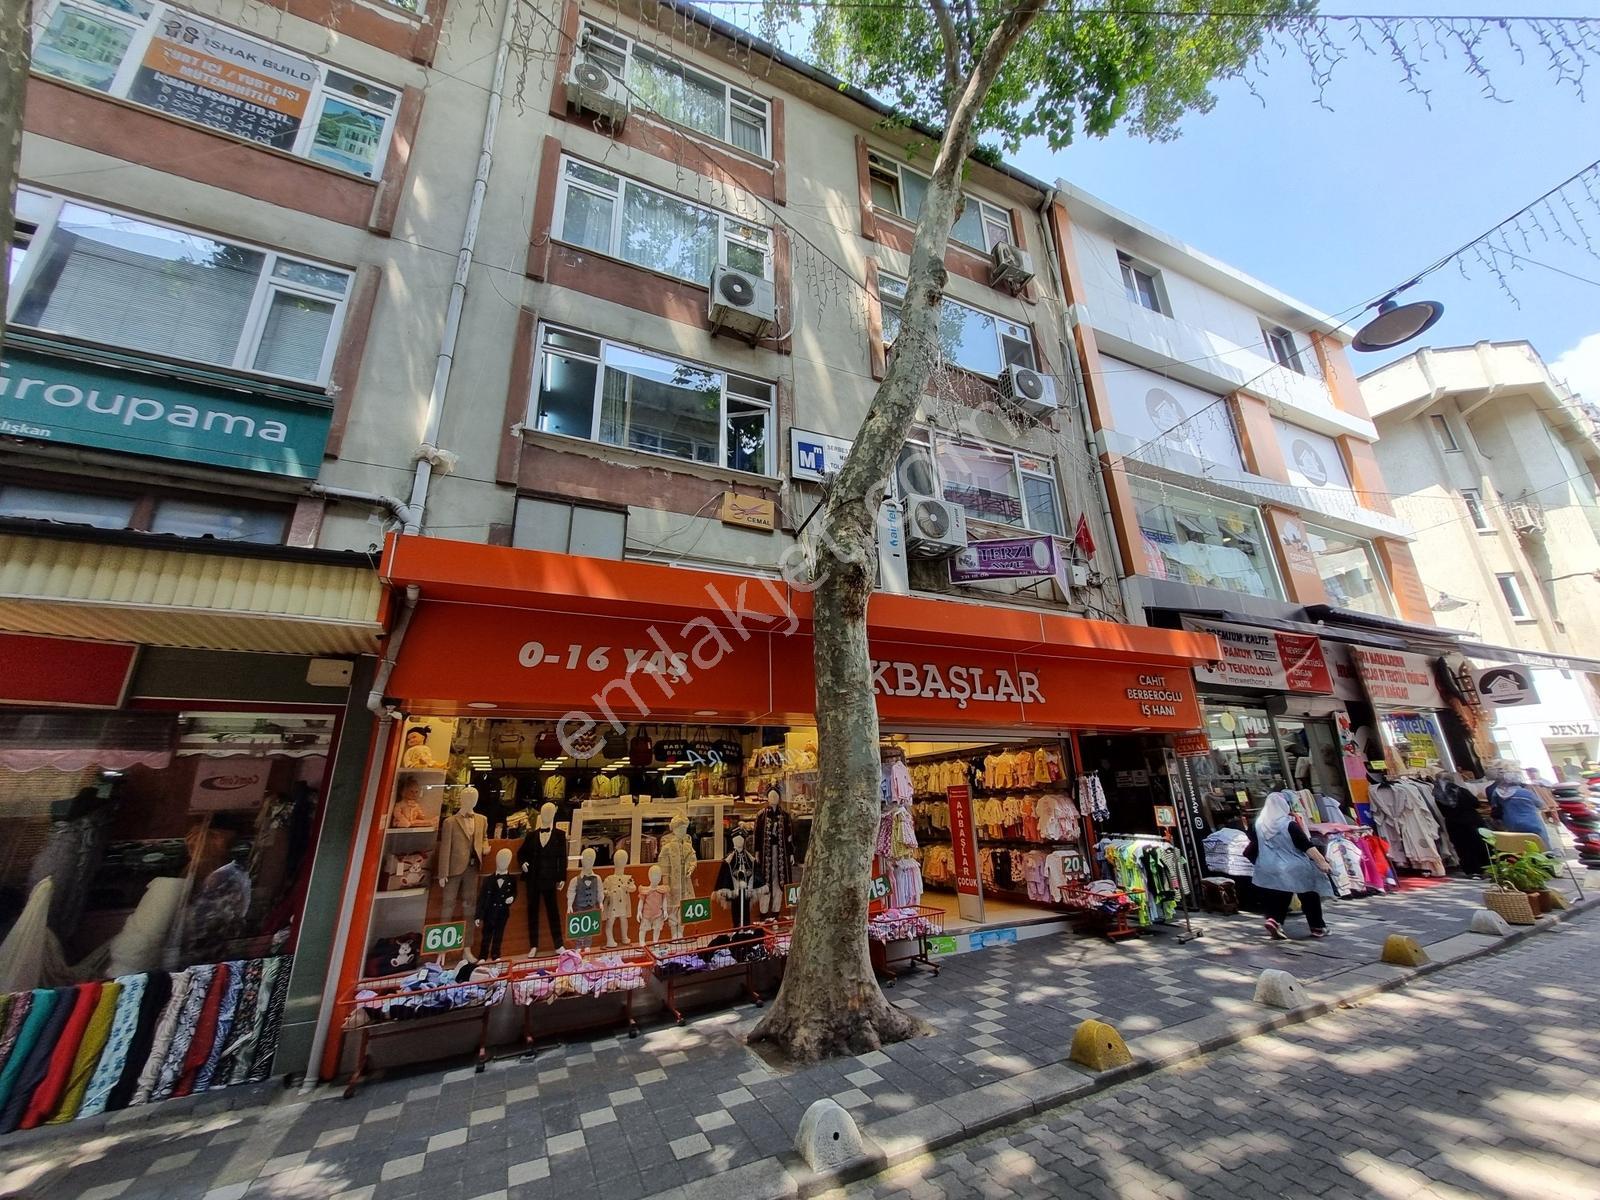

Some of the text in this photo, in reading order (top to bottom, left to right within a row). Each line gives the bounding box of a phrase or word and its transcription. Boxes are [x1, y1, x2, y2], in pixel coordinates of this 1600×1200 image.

[262, 59, 312, 82] BUILD
[176, 90, 204, 105] 535
[208, 100, 235, 116] 746
[239, 109, 257, 123] 72
[171, 98, 200, 114] 555
[204, 108, 233, 124] 540
[236, 116, 255, 131] 34
[257, 126, 276, 139] 56
[0, 420, 51, 437] lışkan
[827, 444, 849, 455] SERBES
[746, 516, 771, 526] CEMAL
[518, 641, 689, 684] 0-16 YAŞ
[1222, 646, 1253, 659] PAMUK
[870, 660, 1046, 709] KBAŞLAR
[1139, 674, 1165, 686] CAHİT
